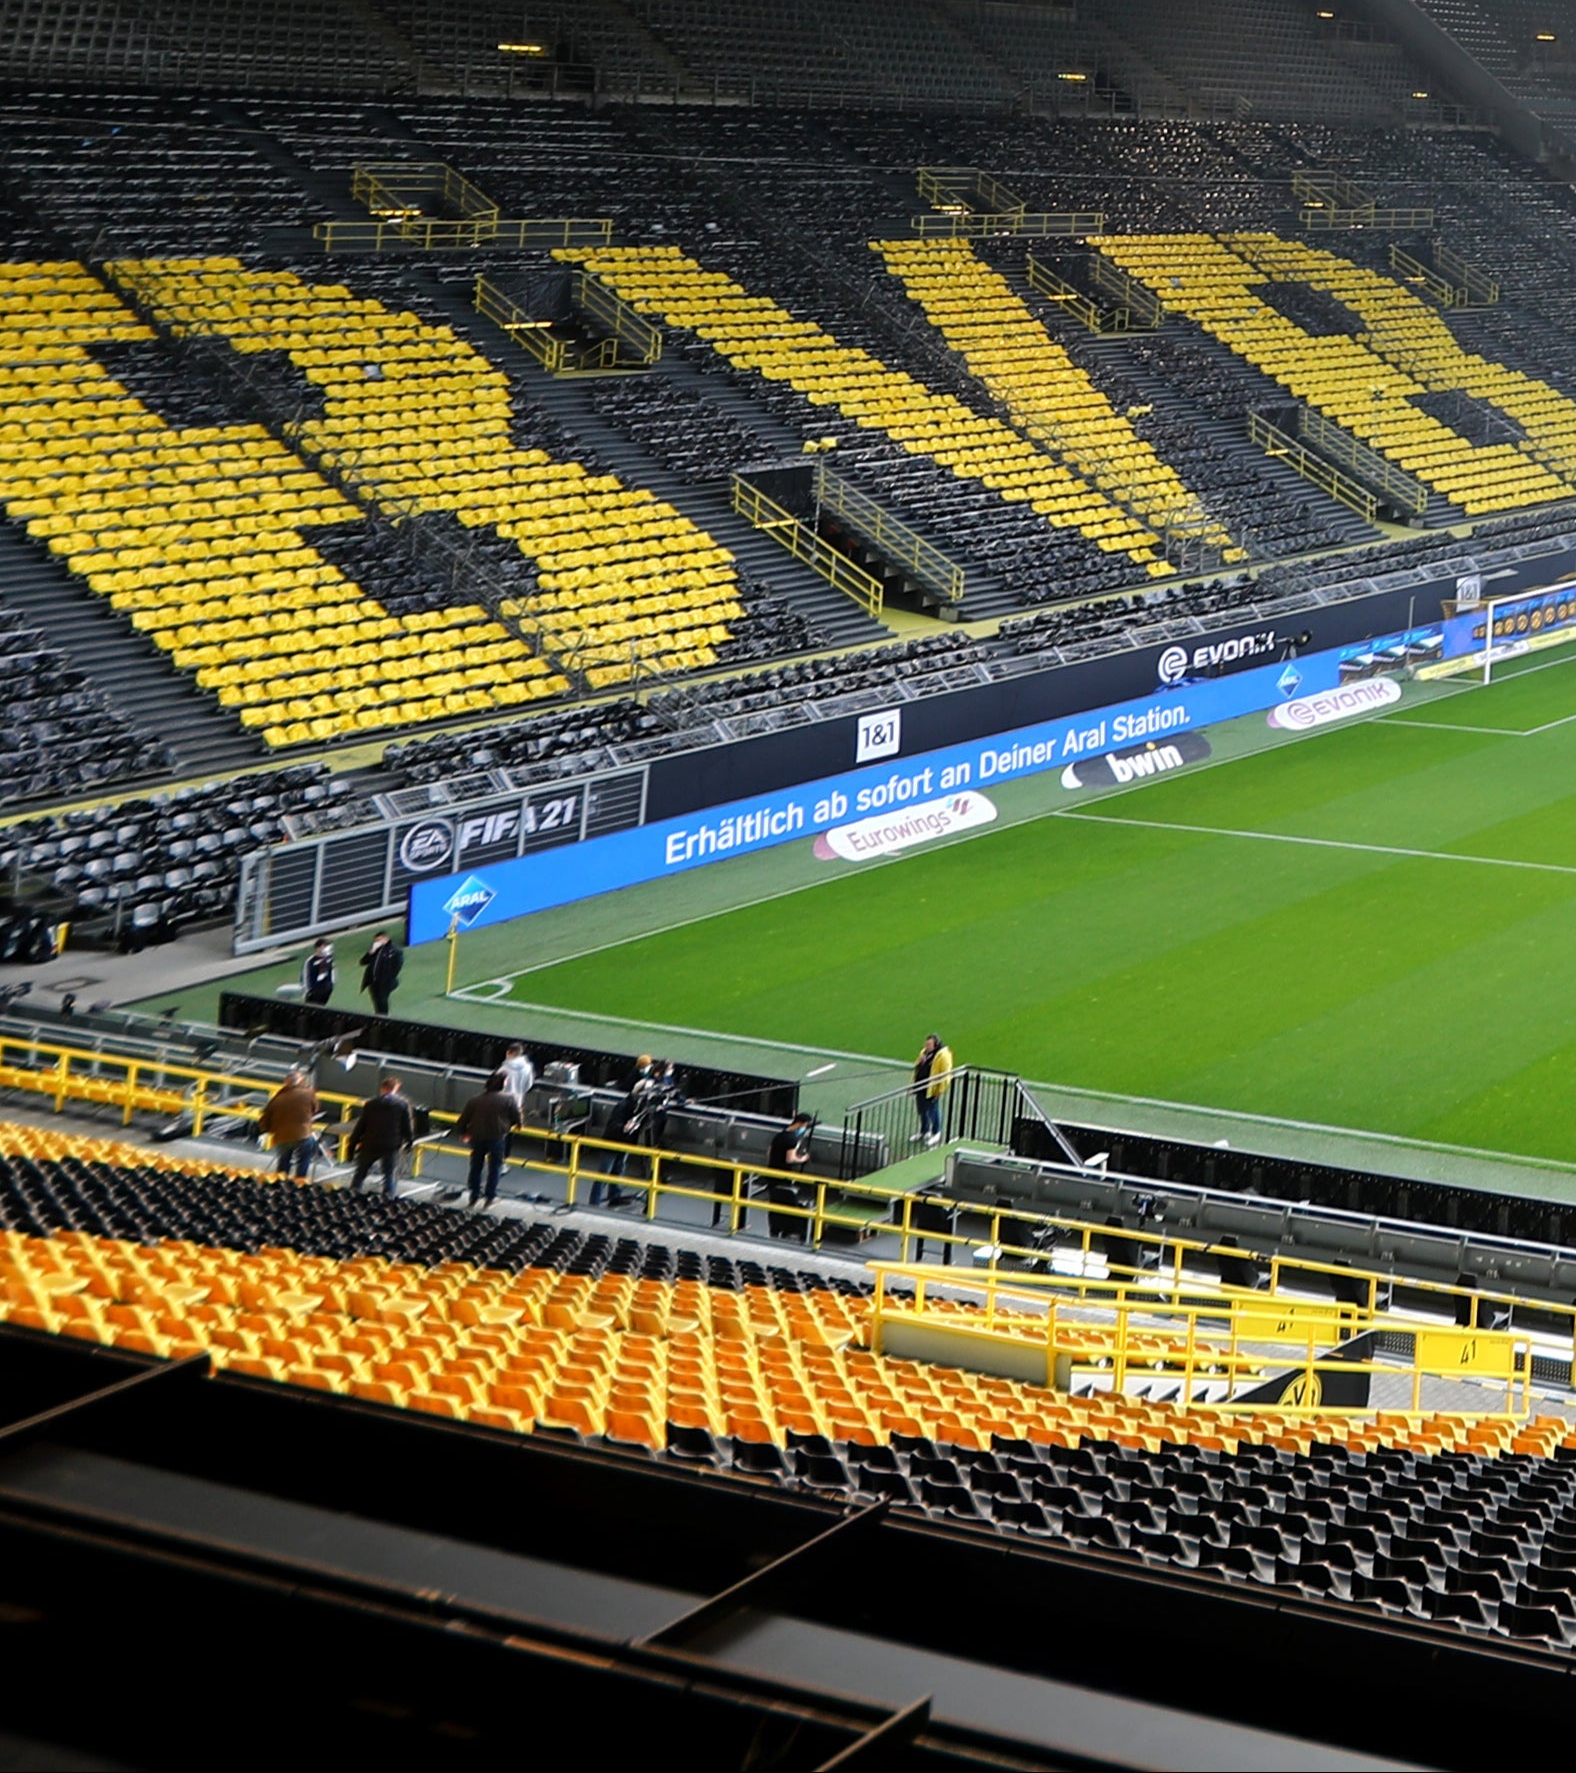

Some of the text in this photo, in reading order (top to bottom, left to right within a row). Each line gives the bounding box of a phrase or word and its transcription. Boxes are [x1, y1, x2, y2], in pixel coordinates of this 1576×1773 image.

[1313, 683, 1390, 715] EVONIK
[861, 720, 895, 749] 1&1
[1105, 742, 1184, 784] bwin
[665, 704, 1192, 865] Erhältlich ab sofort an Deiner Aral Station.
[459, 796, 576, 850] FIFA 21
[846, 808, 951, 853] Eurowings
[411, 829, 446, 851] EA
[451, 890, 490, 909] ARAL
[1460, 1339, 1477, 1366] 41
